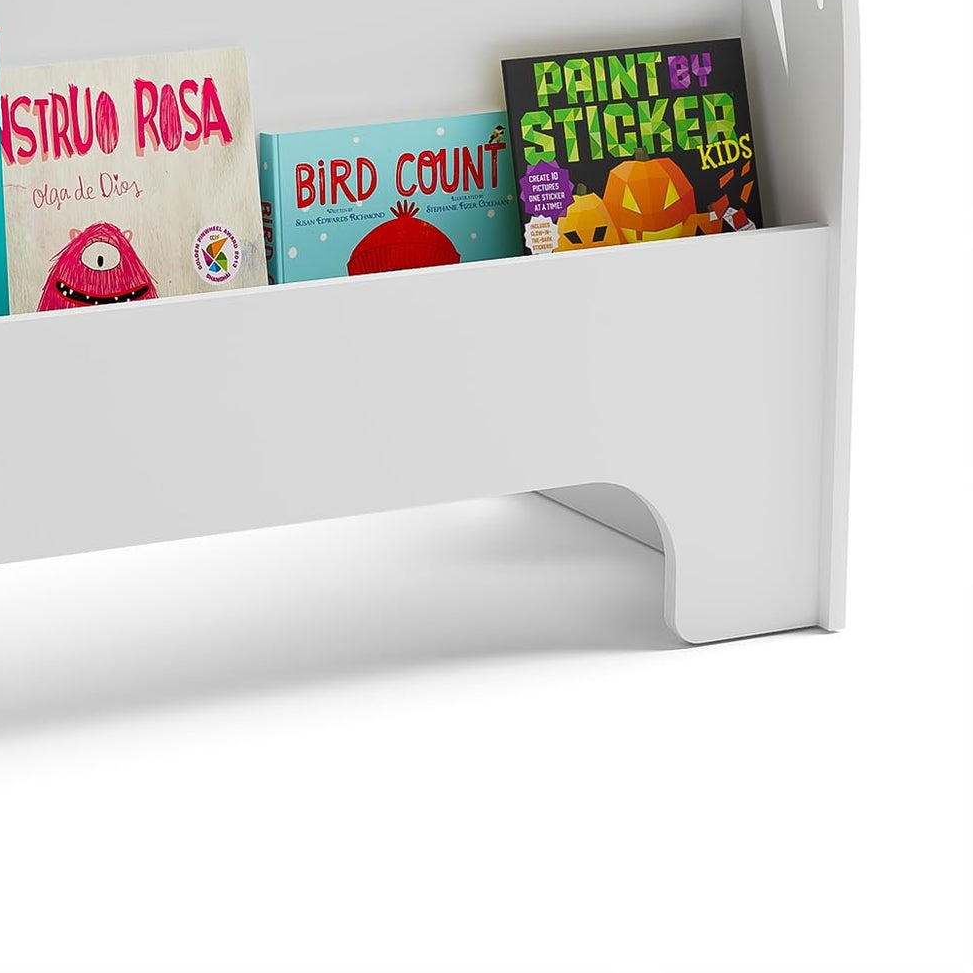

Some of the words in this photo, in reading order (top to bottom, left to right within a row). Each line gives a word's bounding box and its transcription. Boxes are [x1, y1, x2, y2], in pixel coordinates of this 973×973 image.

[533, 51, 663, 108] PAINT
[667, 52, 712, 90] BY
[132, 74, 234, 155] ROSA
[520, 92, 738, 166] STICKER
[696, 132, 753, 170] KIDS
[396, 142, 507, 197] COUNT
[528, 174, 550, 183] CREATE
[551, 172, 558, 181] 10
[74, 175, 97, 201] de
[99, 172, 144, 199] Dios
[528, 194, 541, 203] ONE
[541, 192, 565, 201] STICKER
[532, 183, 559, 192] PICTURES
[316, 215, 349, 225] EDWARDS
[349, 211, 386, 222] RICHMOND
[534, 204, 542, 212] AT
[546, 202, 563, 211] TIME!
[197, 226, 222, 242] PINWHEEL
[223, 229, 238, 249] AWARD
[194, 243, 203, 270] GOLDEN
